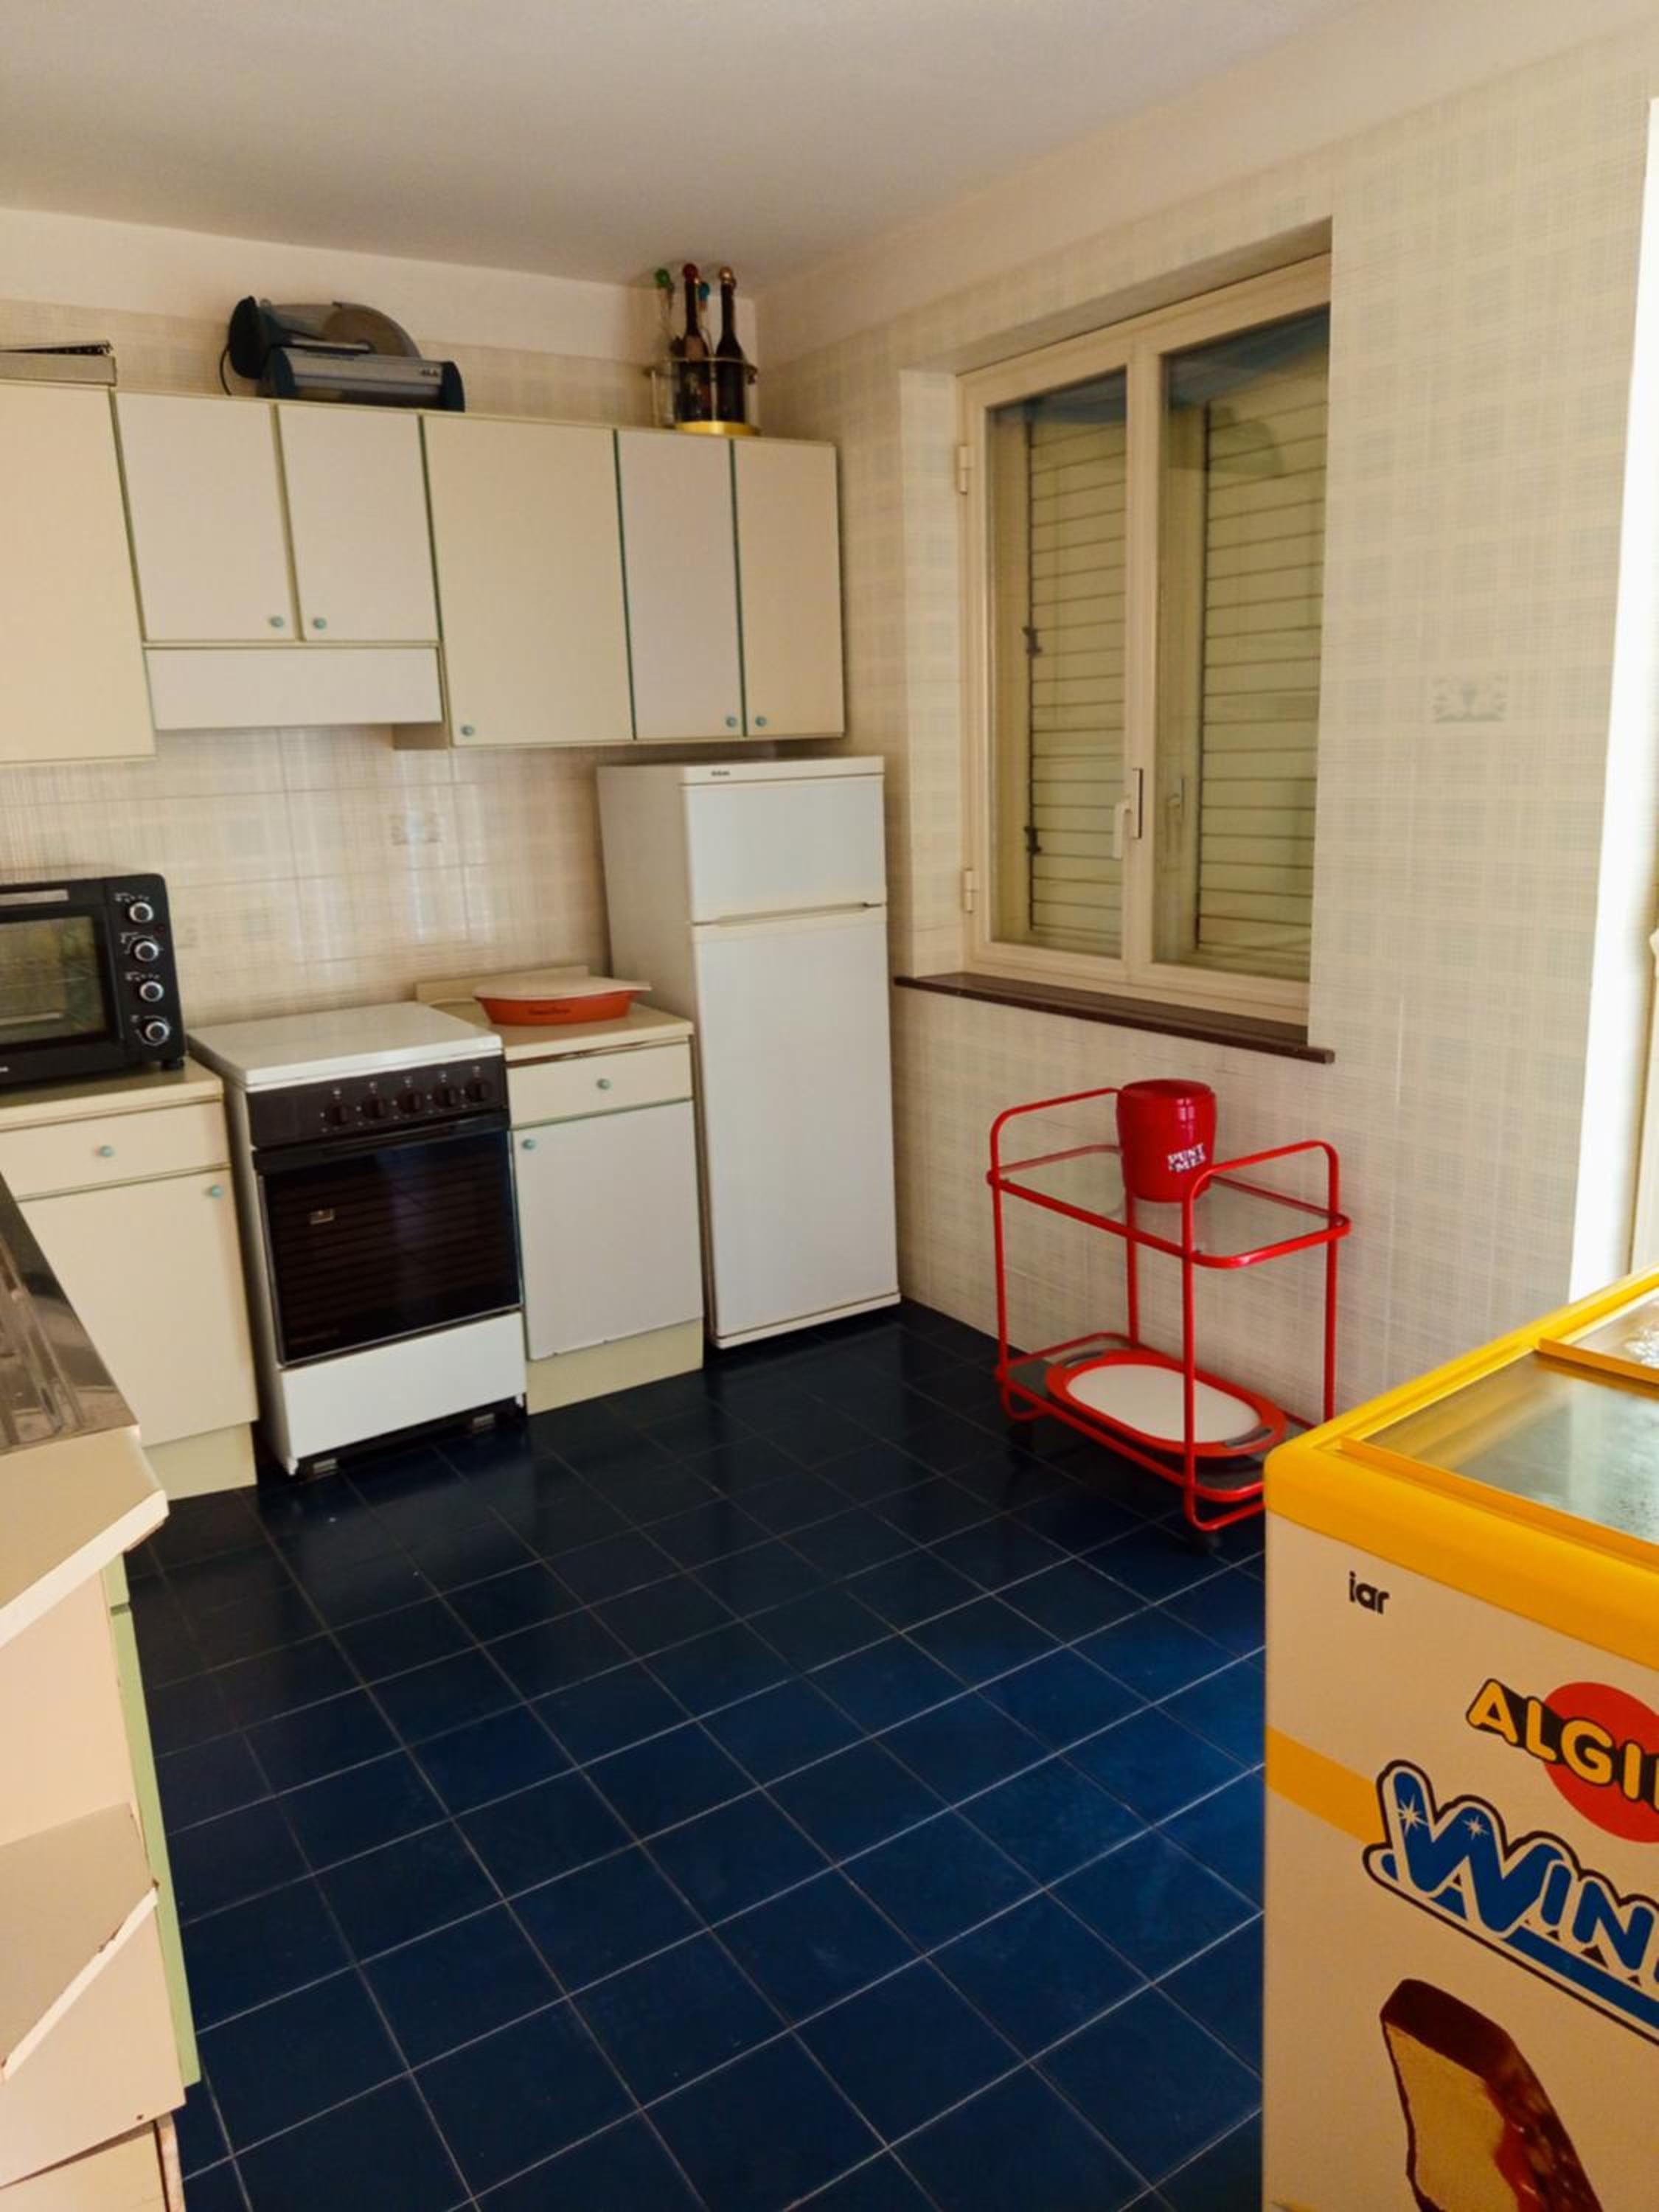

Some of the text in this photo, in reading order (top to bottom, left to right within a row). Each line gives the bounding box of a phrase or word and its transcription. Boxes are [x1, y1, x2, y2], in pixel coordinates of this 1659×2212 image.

[1349, 1570, 1390, 1615] iar
[1466, 1678, 1659, 1814] ALGI
[1377, 1764, 1659, 1983] WIN
